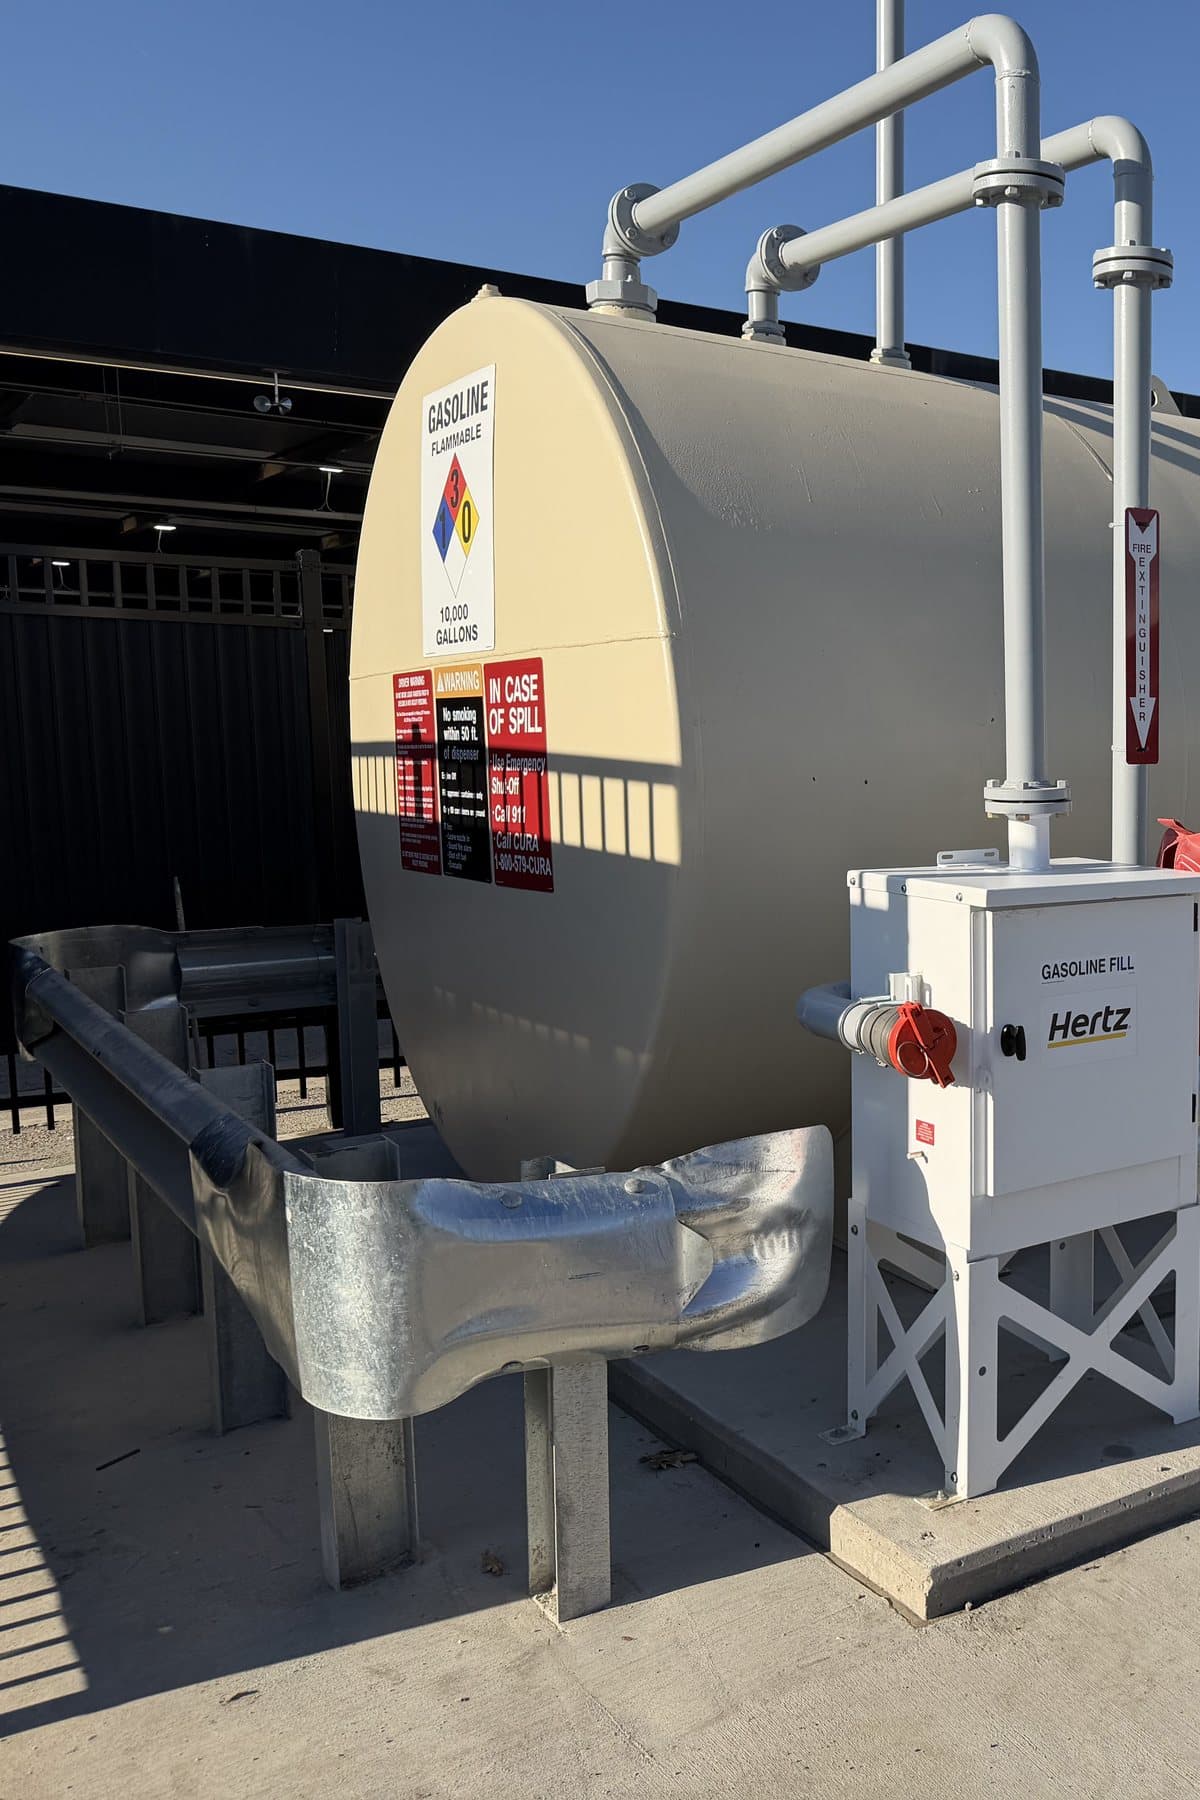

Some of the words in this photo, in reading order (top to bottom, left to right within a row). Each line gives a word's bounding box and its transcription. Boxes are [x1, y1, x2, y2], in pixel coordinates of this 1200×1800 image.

[428, 380, 489, 434] GASOLINE
[431, 423, 482, 456] FLAMMABLE
[450, 468, 459, 508] 3
[440, 508, 447, 549] 1
[461, 500, 471, 543] 0
[1132, 543, 1151, 553] FIRE
[440, 603, 468, 624] 10,000
[436, 624, 478, 646] GALLONS
[1138, 557, 1146, 721] EXTINGUISHER
[444, 671, 480, 691] WARNING
[489, 677, 501, 704] IN
[505, 674, 539, 704] CASE
[442, 707, 451, 722] No
[452, 706, 476, 724] smoking
[489, 708, 505, 735] OF
[509, 707, 543, 735] SPILL
[444, 726, 460, 741] within
[461, 726, 470, 741] 50
[444, 746, 450, 760] of
[452, 746, 479, 763] dispenser
[492, 754, 505, 771] Use
[506, 754, 546, 776] Emergency
[511, 805, 526, 824] 911
[496, 832, 512, 850] Call
[514, 834, 539, 852] CURA
[494, 855, 553, 877] 1-800-579-CURA
[1041, 958, 1106, 980] GASOLINE
[1109, 955, 1135, 972] FILL
[1048, 1005, 1131, 1042] Hertz
